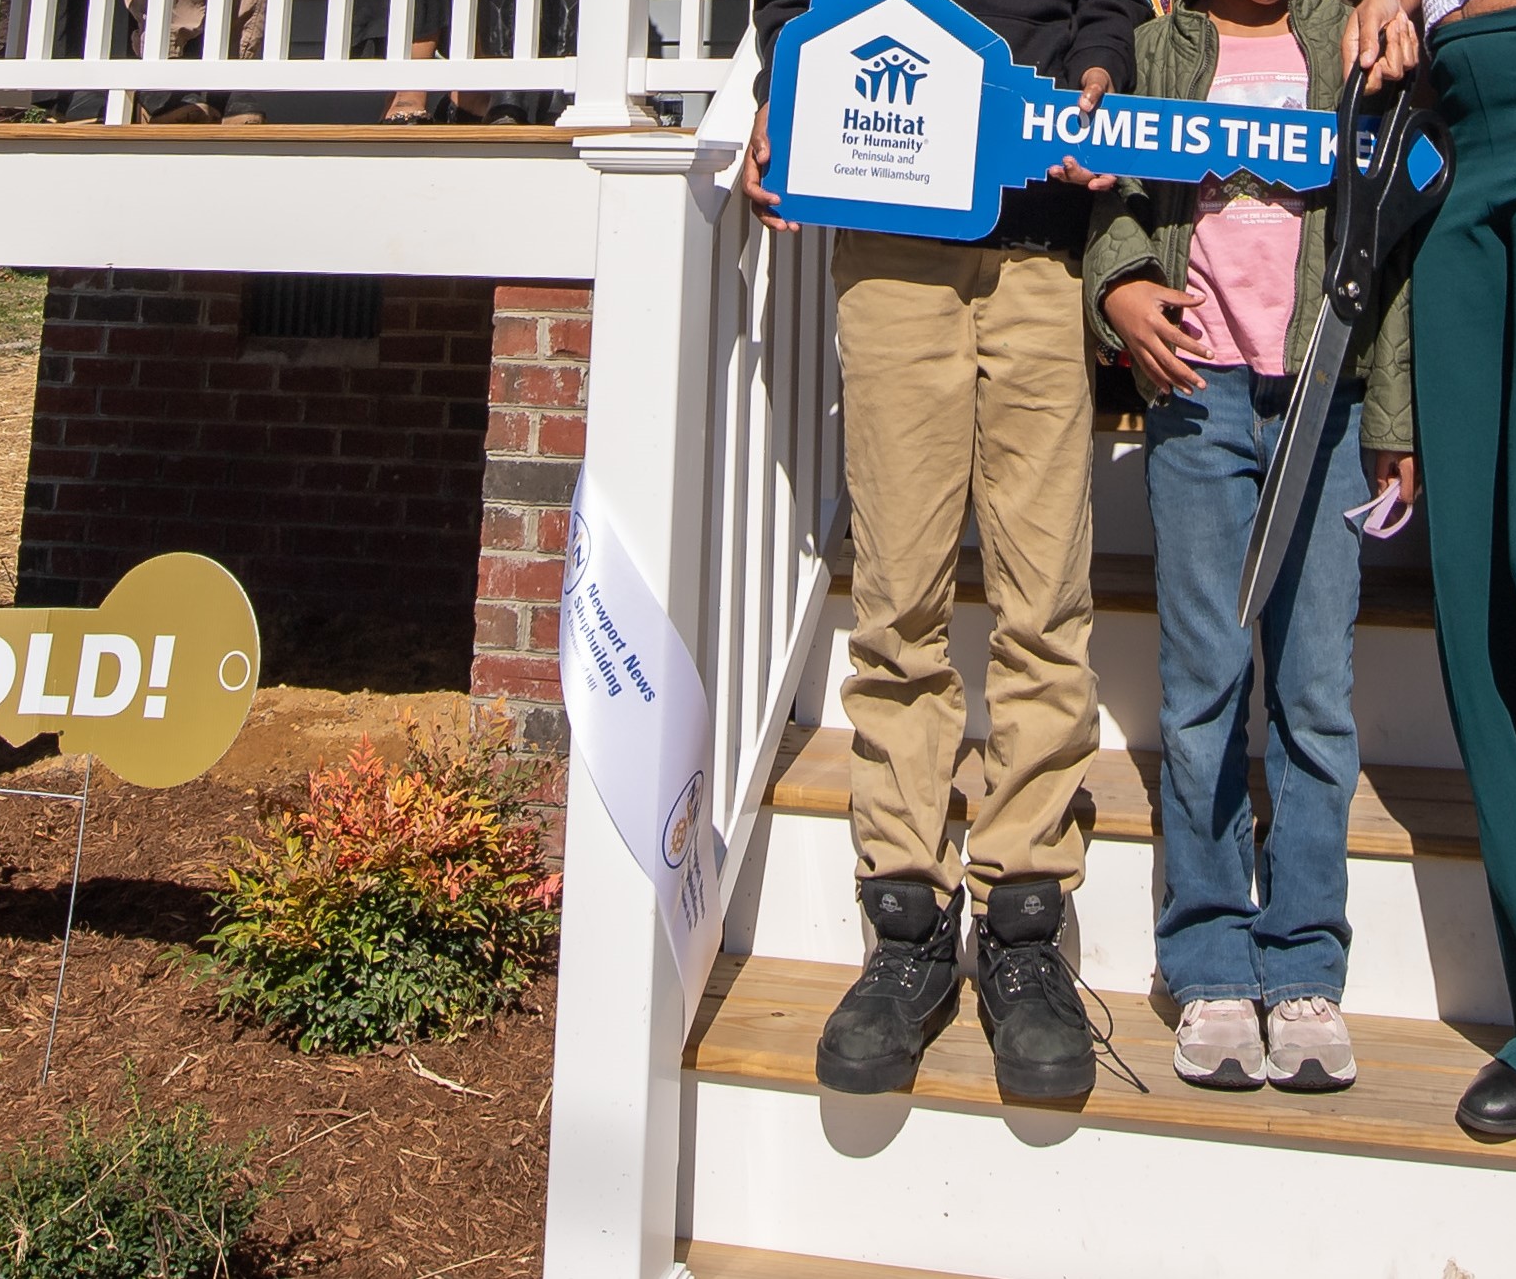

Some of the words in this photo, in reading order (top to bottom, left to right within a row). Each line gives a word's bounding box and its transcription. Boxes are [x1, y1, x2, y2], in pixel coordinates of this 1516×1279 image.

[843, 108, 925, 137] Habitat
[1022, 101, 1160, 151] HOME
[1170, 114, 1212, 156] IS
[1220, 119, 1309, 165] THE
[1320, 125, 1377, 169] KE
[842, 132, 859, 147] for
[852, 149, 895, 164] Peninsula
[897, 153, 915, 165] and
[834, 163, 868, 177] Greater
[871, 167, 930, 185] Williamsburg
[574, 595, 623, 698] Shipbuilding
[587, 583, 627, 653] Newport
[623, 654, 656, 703] News
